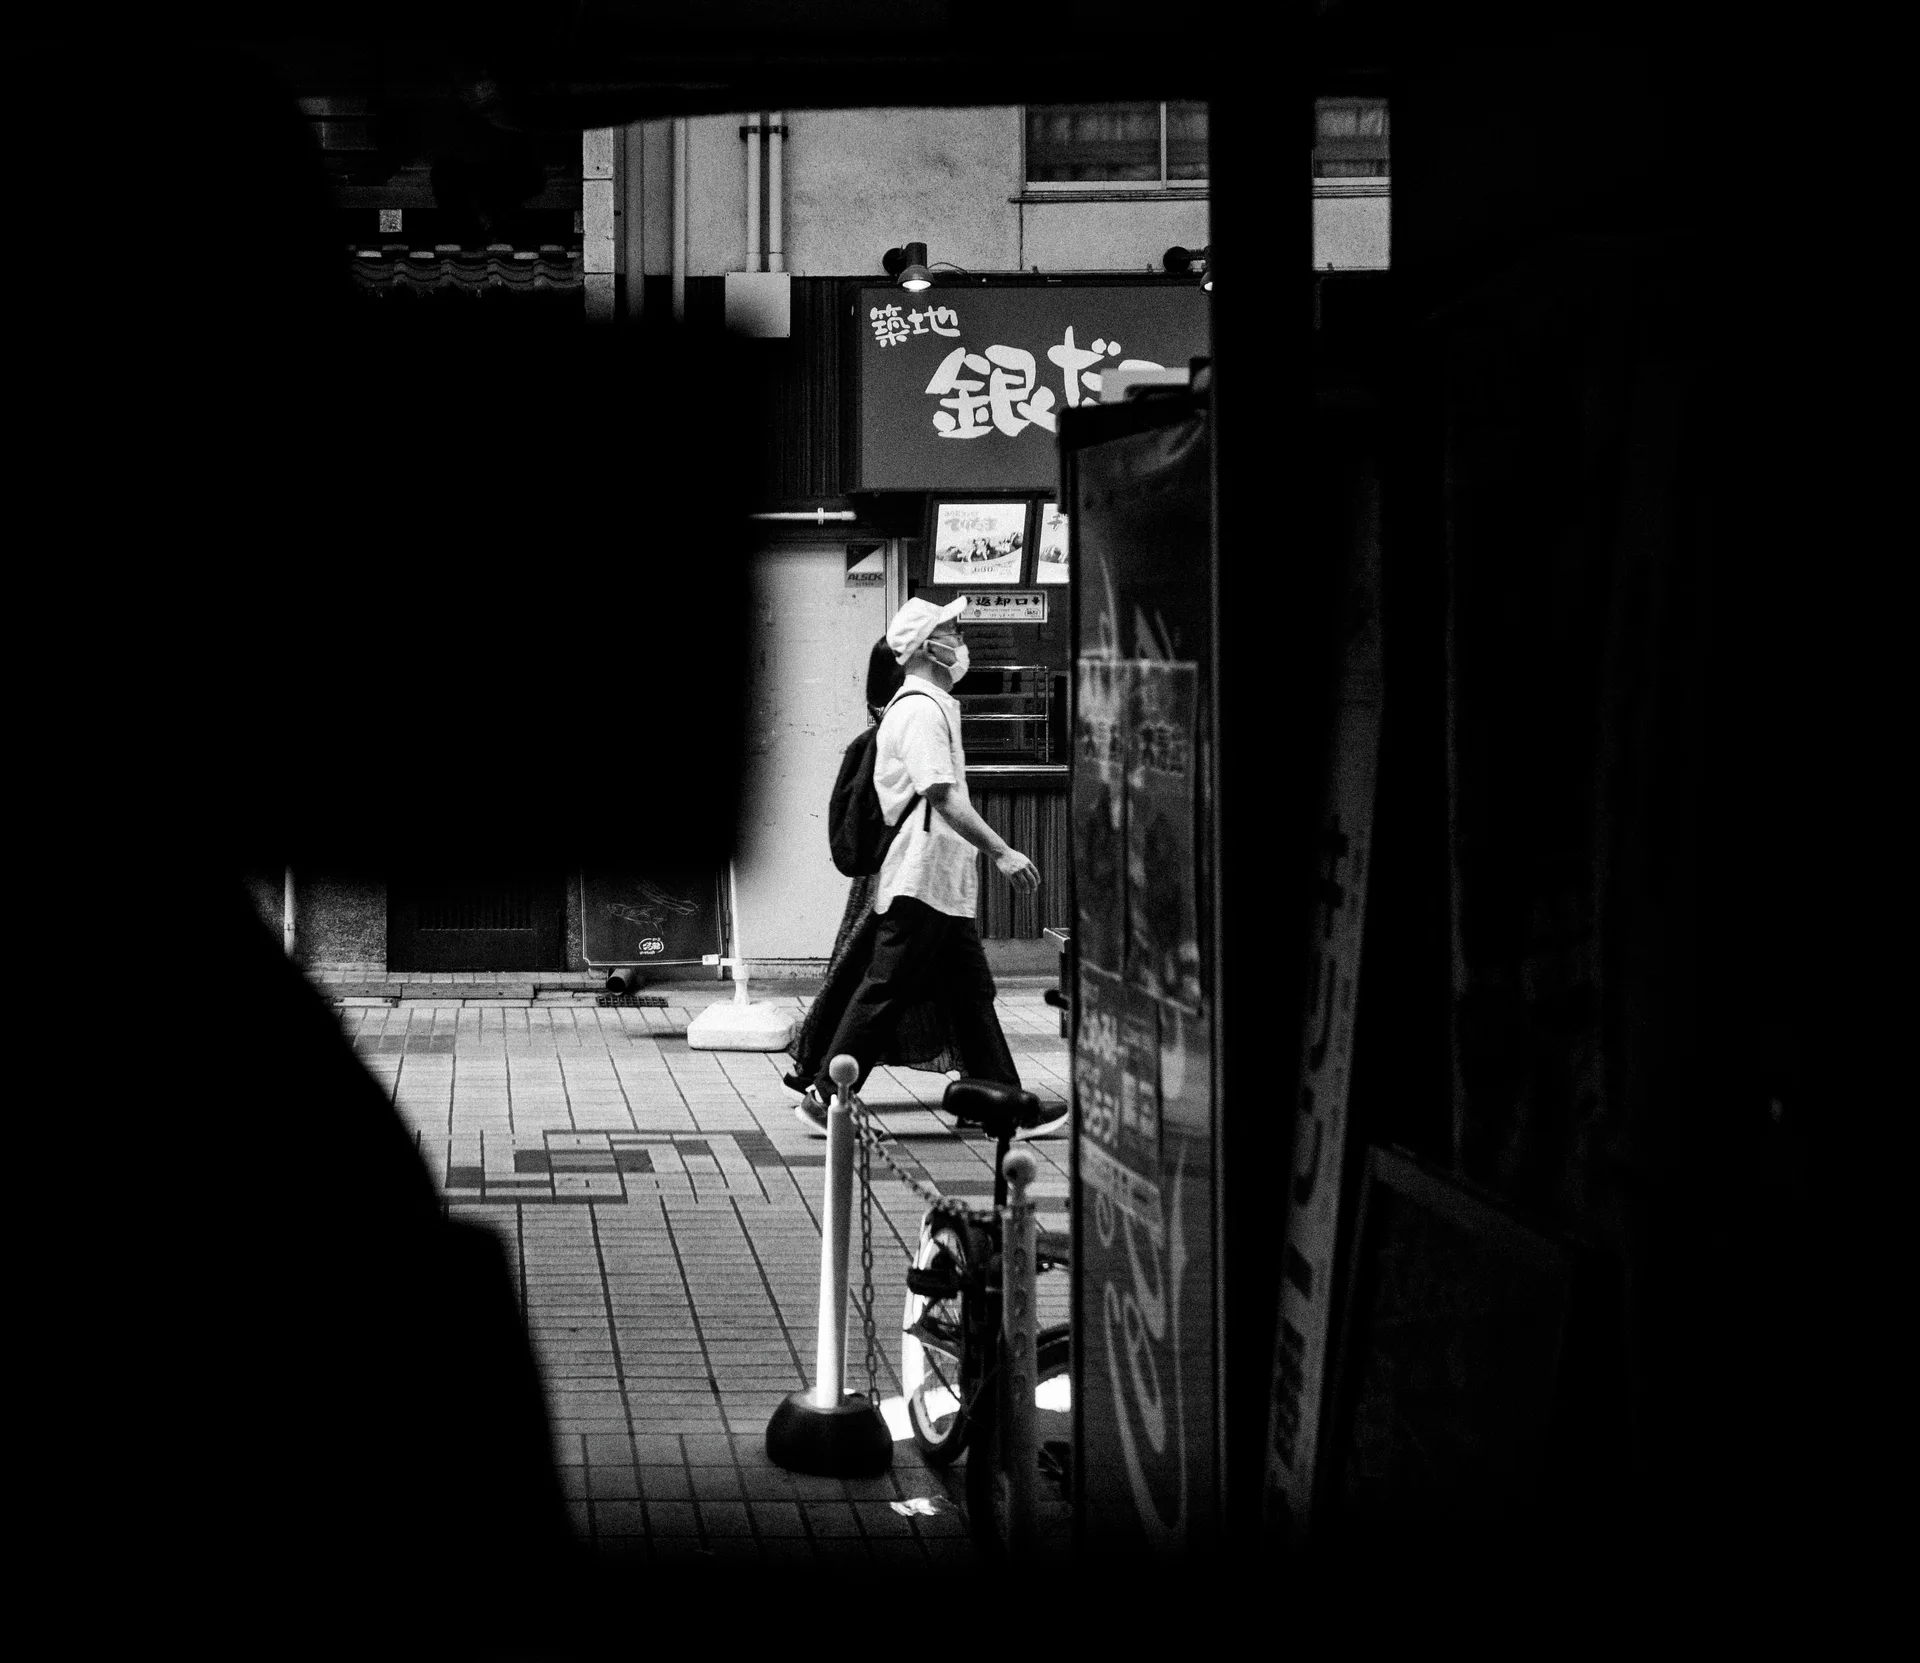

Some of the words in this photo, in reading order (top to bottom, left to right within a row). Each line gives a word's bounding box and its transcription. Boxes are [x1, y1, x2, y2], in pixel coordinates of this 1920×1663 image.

[869, 304, 961, 347] 築地
[925, 325, 1166, 439] 銀だ
[976, 596, 1029, 607] 返却口
